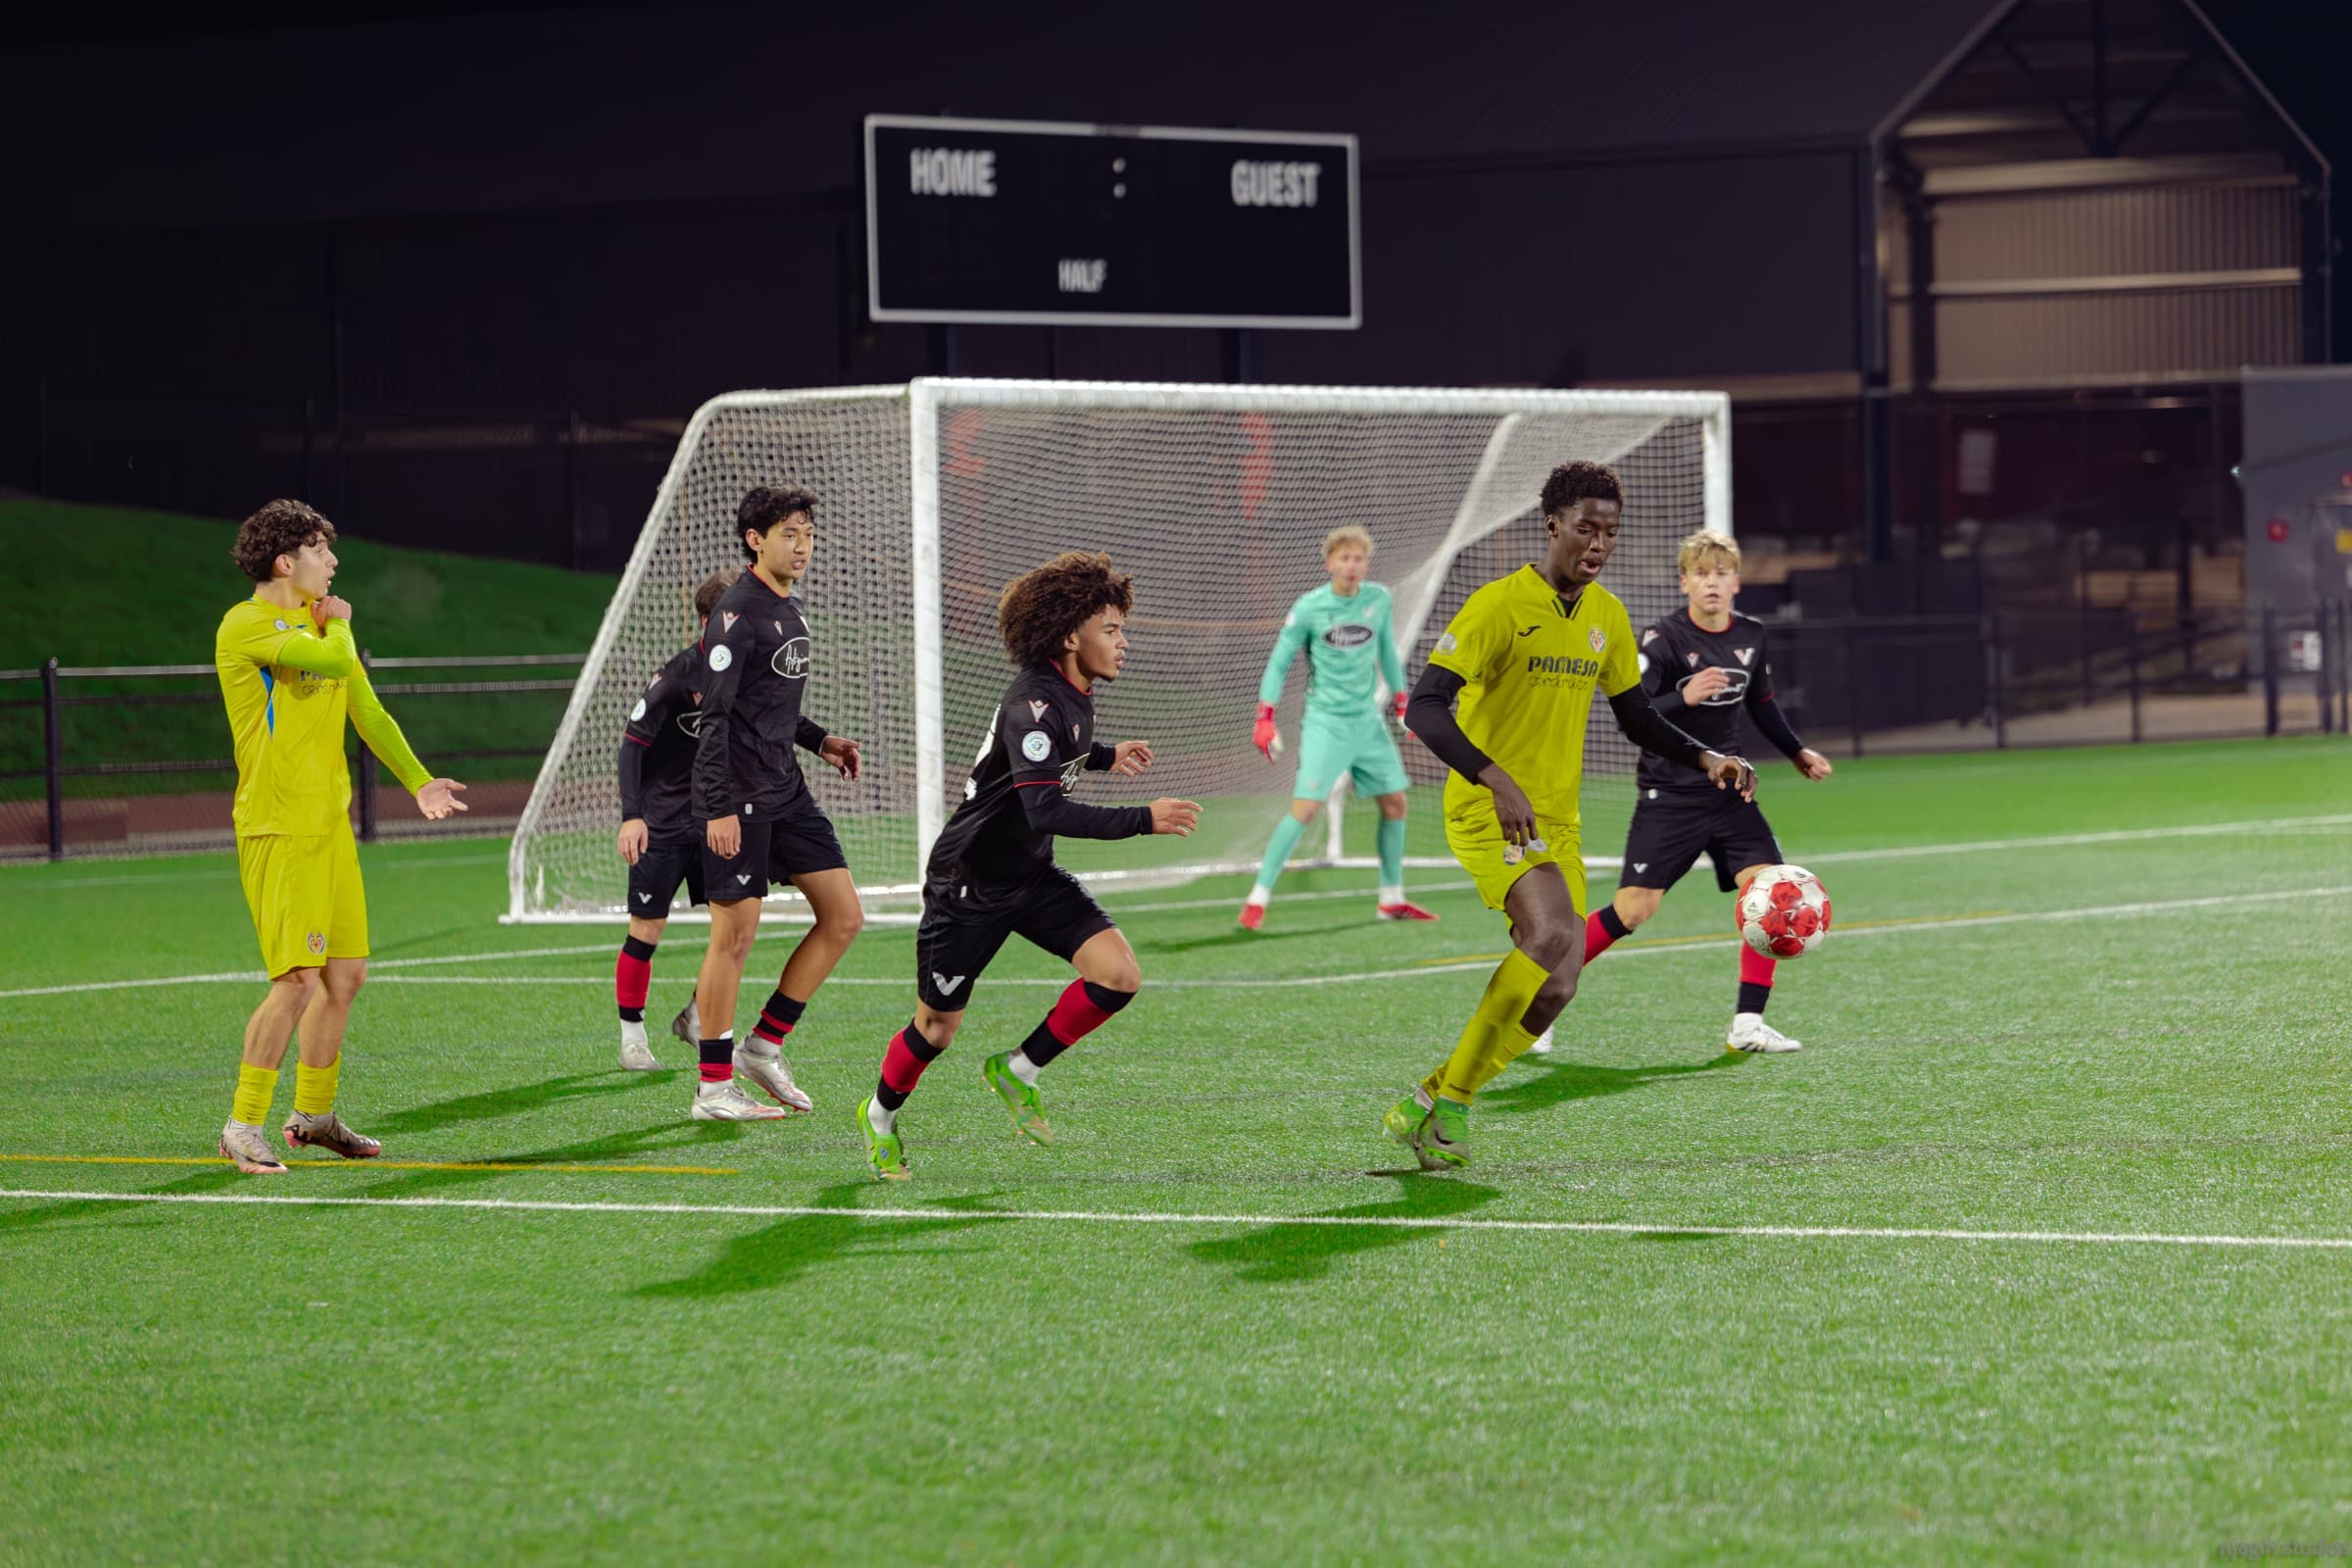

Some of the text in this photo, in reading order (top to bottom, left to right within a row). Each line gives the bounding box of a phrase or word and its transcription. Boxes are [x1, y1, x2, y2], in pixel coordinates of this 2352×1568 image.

[909, 147, 997, 197] HOME
[1230, 160, 1322, 207] GUEST
[1057, 258, 1107, 293] HALF
[1528, 656, 1598, 678] PAMESA
